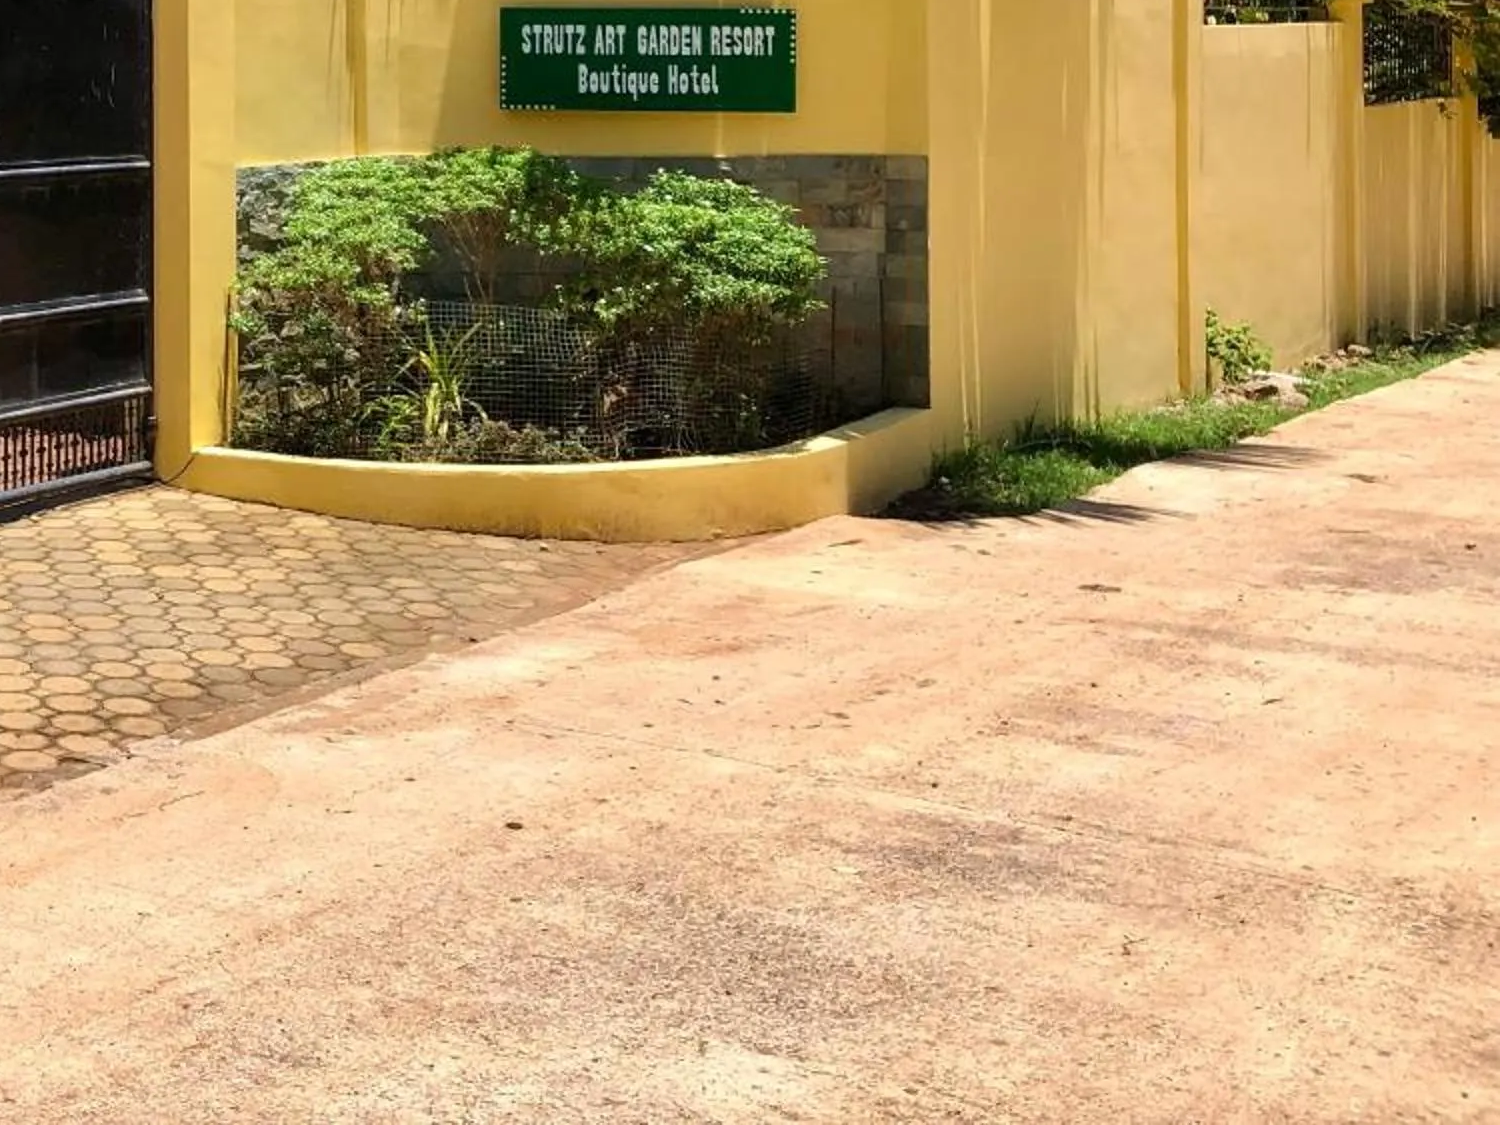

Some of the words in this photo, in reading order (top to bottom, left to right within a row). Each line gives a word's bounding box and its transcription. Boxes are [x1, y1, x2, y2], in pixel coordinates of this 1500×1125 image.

[522, 24, 586, 55] STRUTZ
[594, 25, 626, 55] ART
[637, 25, 702, 56] GARDEN
[710, 26, 775, 56] RESORT
[578, 64, 659, 101] Boutique
[668, 64, 719, 94] Hotel
